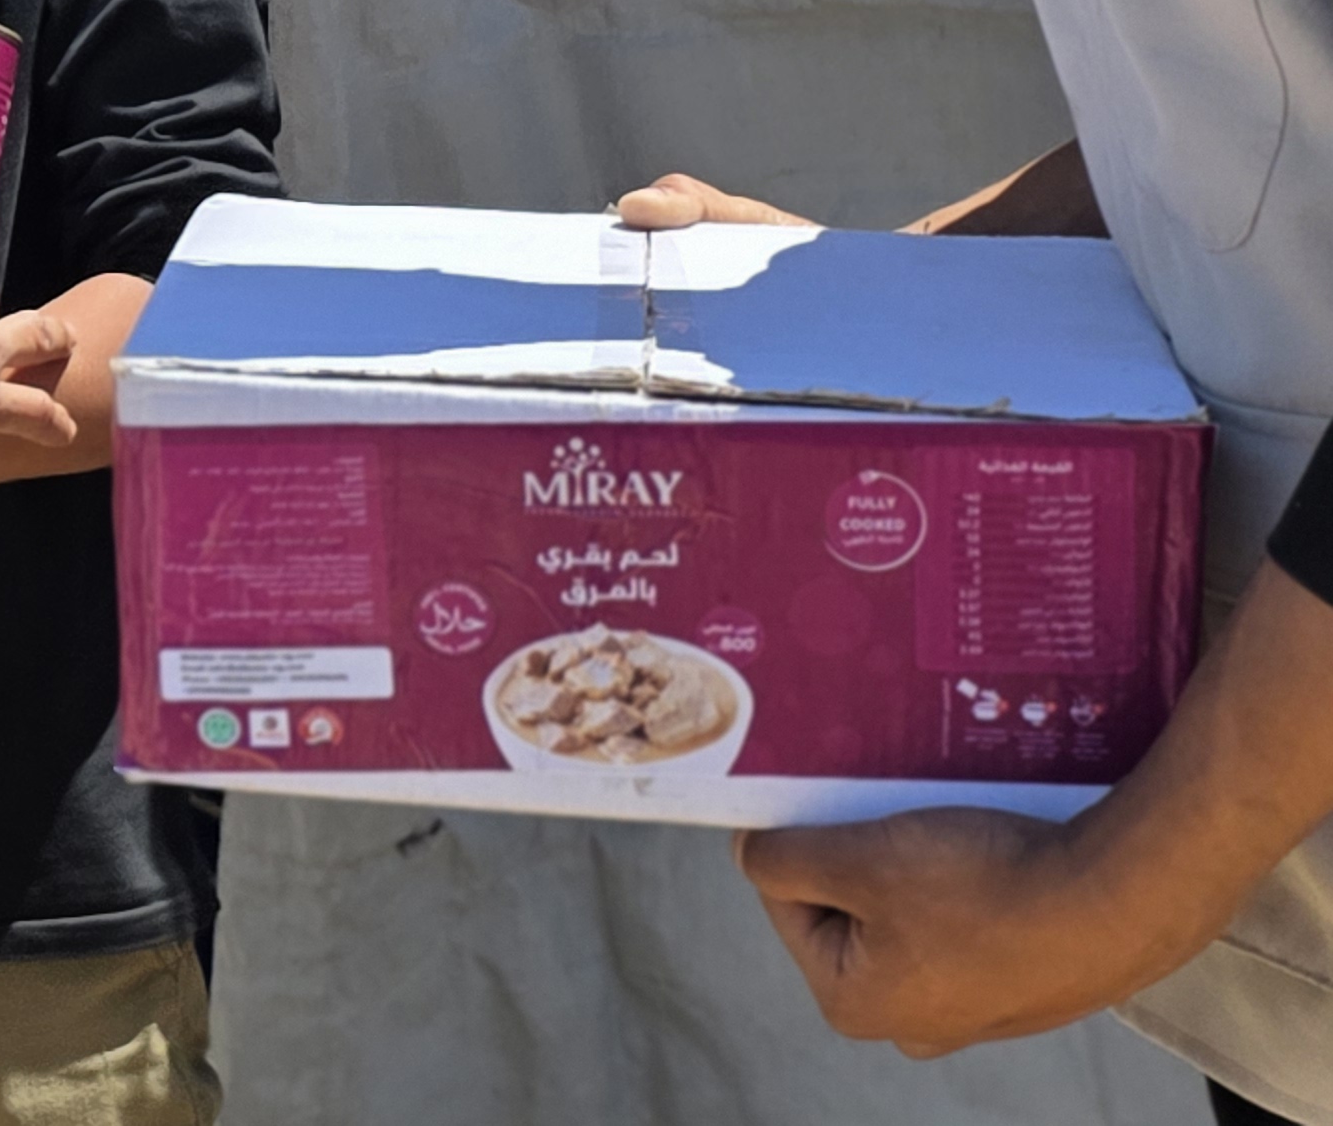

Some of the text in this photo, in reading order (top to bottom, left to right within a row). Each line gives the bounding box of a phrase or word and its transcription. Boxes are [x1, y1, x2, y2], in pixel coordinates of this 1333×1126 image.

[847, 495, 897, 510] FULLY
[839, 517, 906, 532] COOKED
[536, 541, 680, 574] لحم بقري
[560, 576, 657, 607] بالمرق
[719, 636, 756, 652] 800
